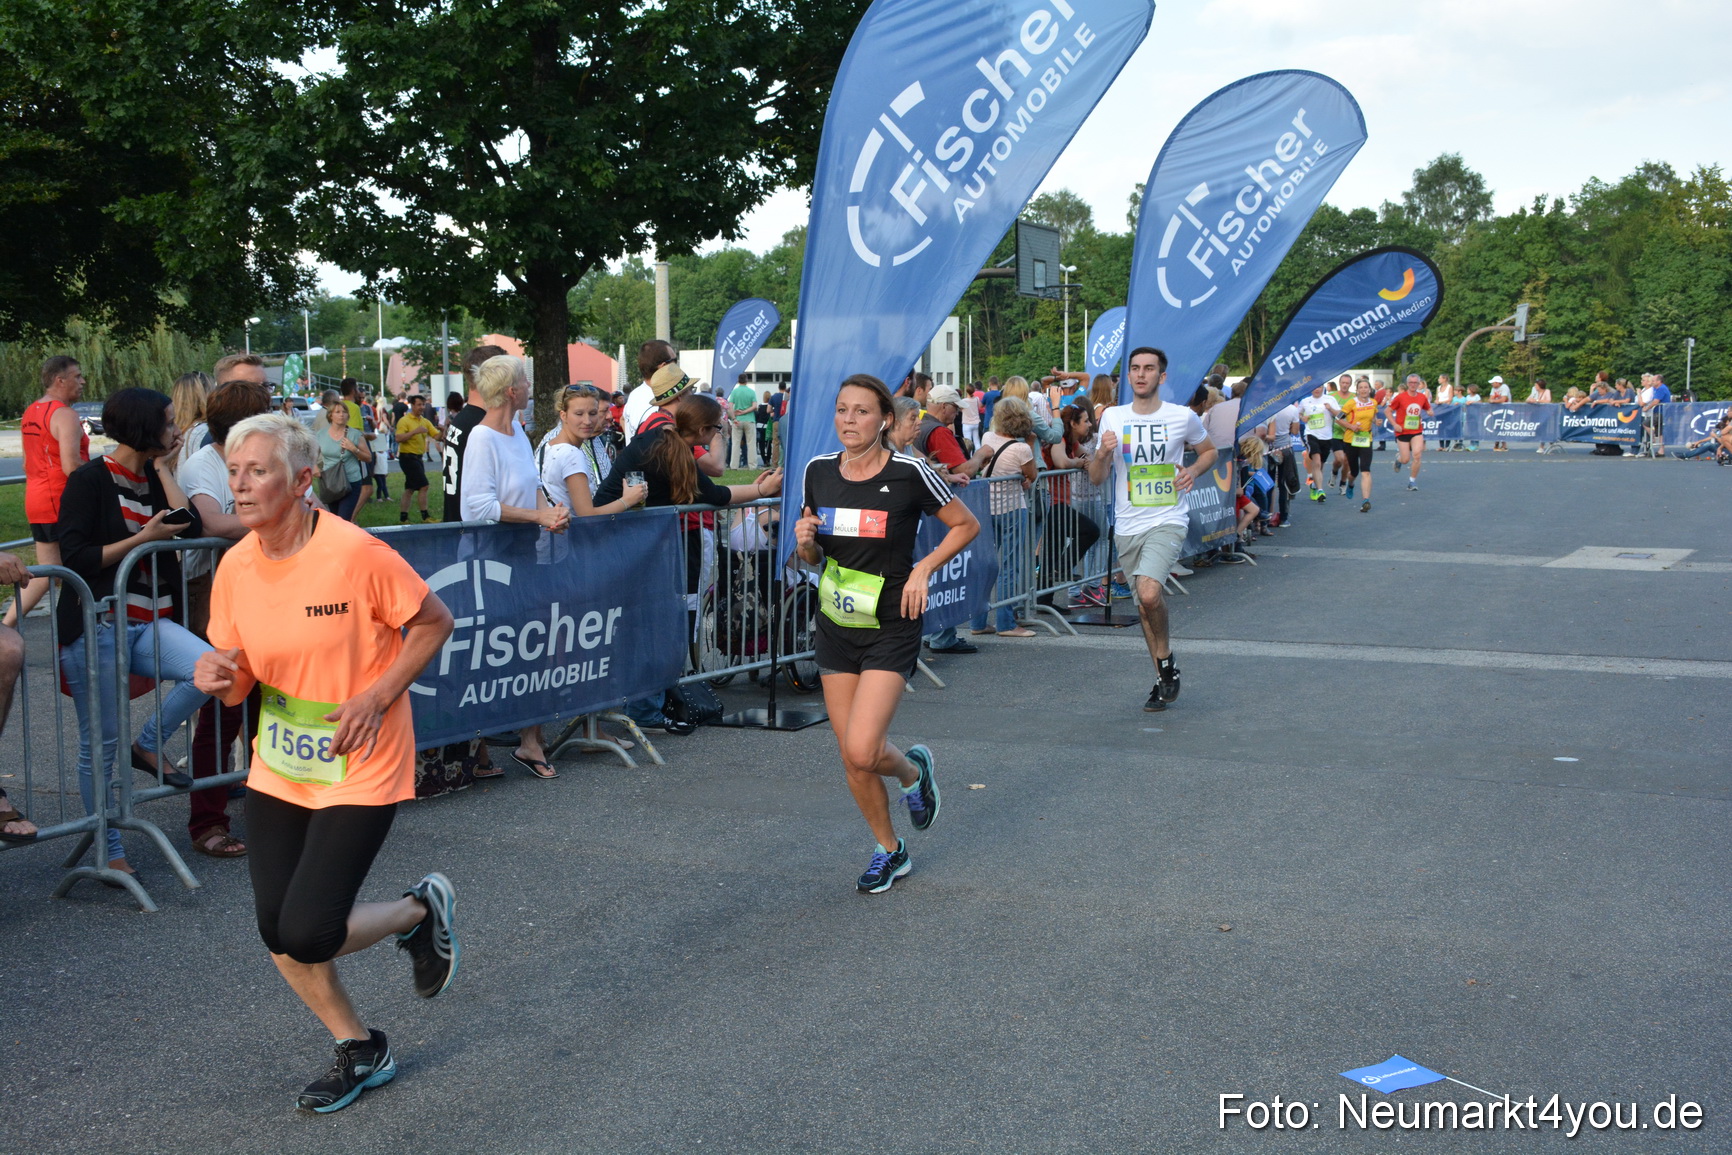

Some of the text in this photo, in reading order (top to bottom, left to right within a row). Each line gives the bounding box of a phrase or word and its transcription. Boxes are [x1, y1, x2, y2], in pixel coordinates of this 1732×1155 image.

[952, 21, 1097, 225] AUTOMOBILE
[1186, 107, 1314, 280] Fischer
[1230, 137, 1328, 276] AUTOMOBILE
[728, 309, 766, 361] Fischer
[740, 319, 770, 360] AUTOMOBILE
[1099, 317, 1126, 360] Fische
[1272, 302, 1392, 376] Frischmann
[1348, 295, 1432, 346] Druck und Medien
[1408, 407, 1420, 416] 48
[1493, 418, 1541, 431] Fischer
[1134, 443, 1166, 464] AM
[1135, 480, 1173, 496] 1165
[834, 523, 858, 533] MÜLLER
[305, 602, 349, 617] THULE
[832, 590, 855, 614] 36
[439, 602, 622, 676] Fischer
[458, 656, 611, 708] AUTOMOBILE
[267, 722, 336, 763] 1568
